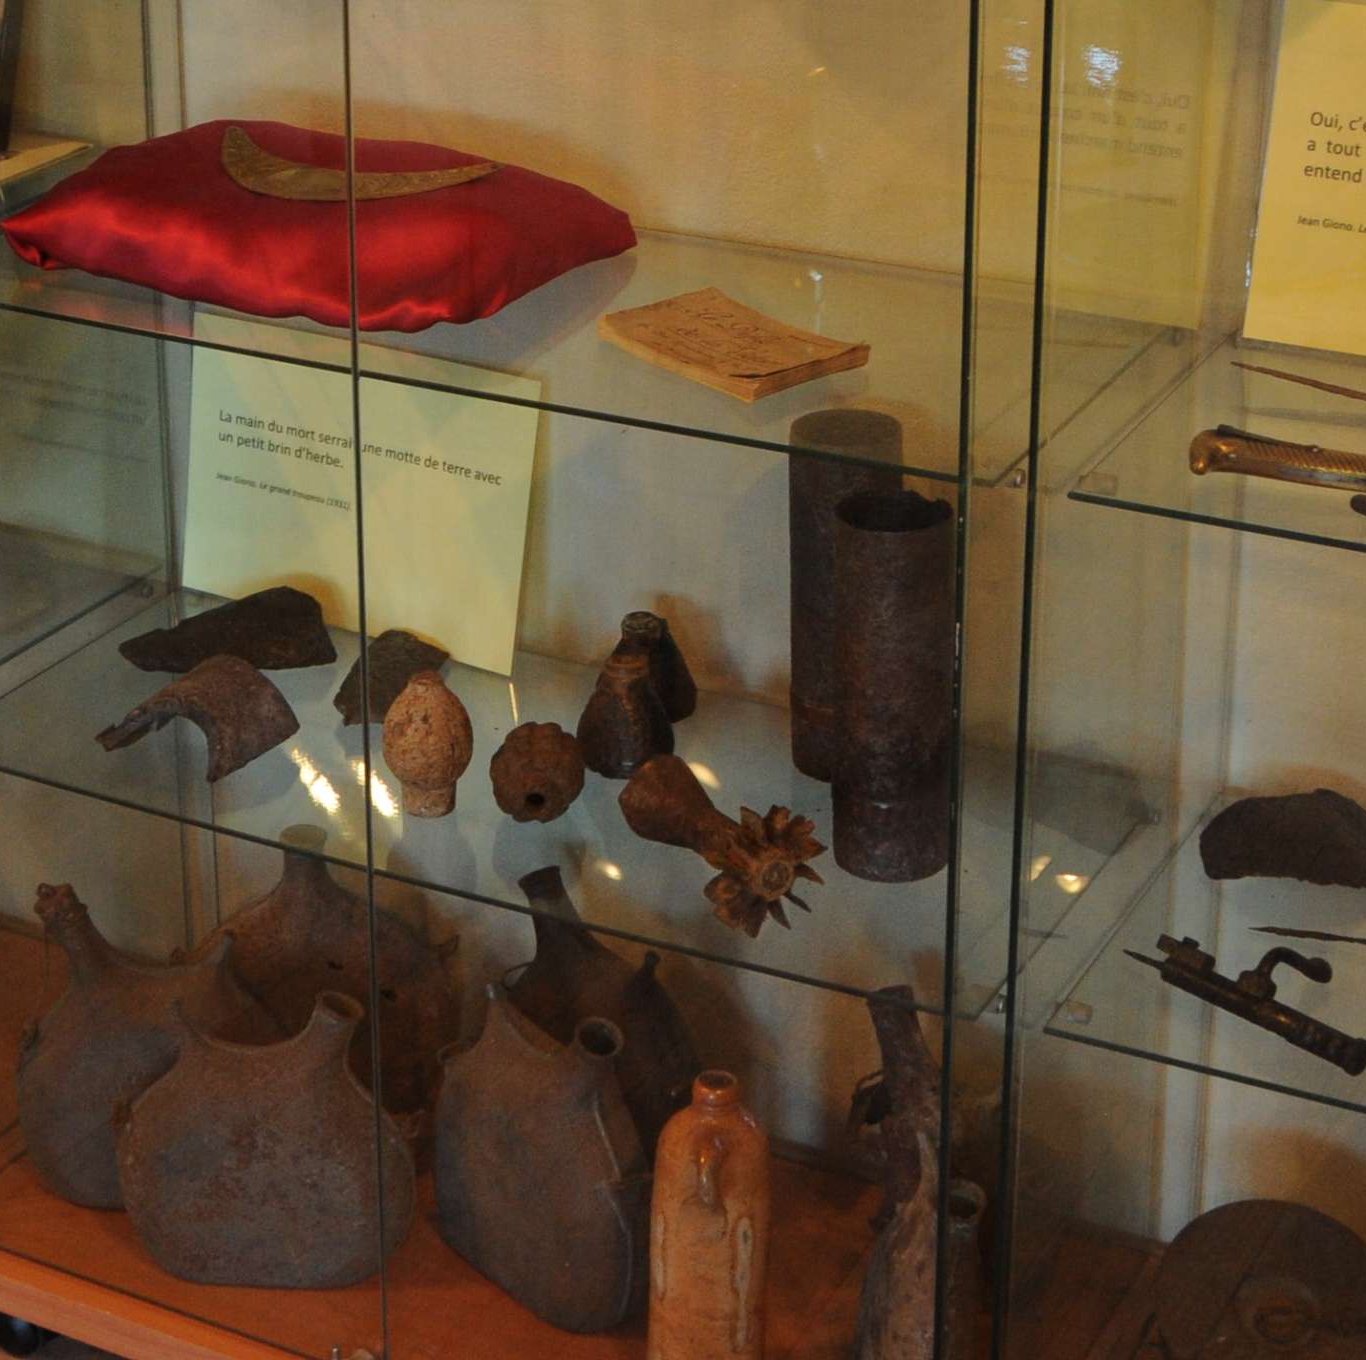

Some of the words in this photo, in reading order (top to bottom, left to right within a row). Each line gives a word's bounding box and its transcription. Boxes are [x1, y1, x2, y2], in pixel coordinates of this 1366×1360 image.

[1310, 112, 1343, 131] Oui,
[1307, 140, 1316, 152] a
[1326, 140, 1361, 158] tout
[1304, 165, 1362, 183] entend
[1297, 215, 1320, 227] Jean
[218, 432, 233, 443] un
[237, 435, 265, 450] petit
[267, 440, 291, 456] brin
[219, 410, 232, 423] La
[235, 415, 265, 429] main
[267, 420, 283, 434] du
[286, 425, 316, 441] mort
[318, 433, 357, 450] serrai
[385, 448, 421, 466] motte
[423, 455, 439, 470] de
[442, 461, 472, 478] terre
[474, 470, 502, 486] avec
